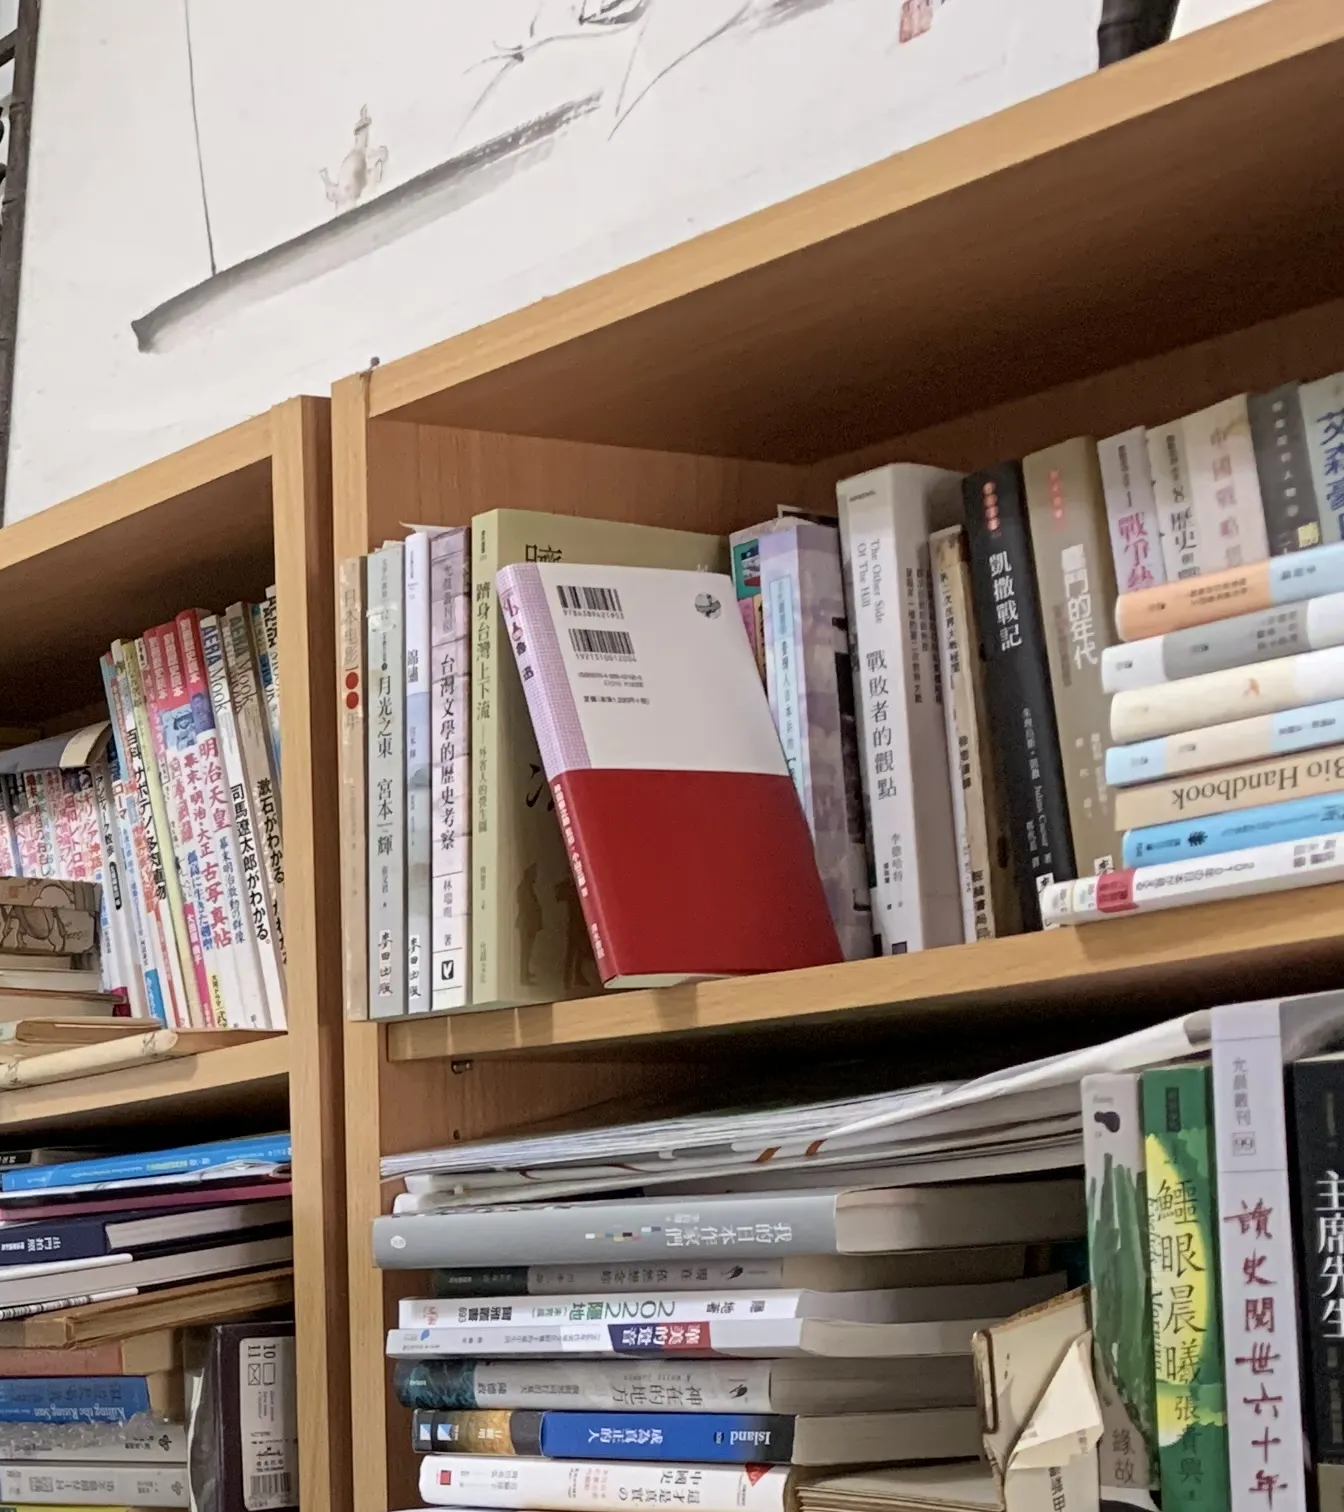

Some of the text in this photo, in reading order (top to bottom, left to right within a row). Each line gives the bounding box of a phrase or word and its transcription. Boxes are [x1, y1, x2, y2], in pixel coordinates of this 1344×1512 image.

[872, 563, 883, 595] Other
[987, 551, 1023, 652] 凱撒戰記
[377, 676, 393, 759] 月光之東
[439, 653, 457, 851] 台灣文學的歷史考察
[865, 650, 898, 799] 戰敗者的觀點
[197, 736, 231, 831] 明治天皇
[1171, 765, 1299, 811] Handbook
[201, 860, 234, 950] 古写真帖
[229, 783, 272, 945] 司馬遼太郎がわかる。
[664, 1221, 793, 1248] 我的日本作家們
[1154, 1178, 1206, 1385] 鱷眼晨曦
[611, 1384, 703, 1405] 神在的地方
[1223, 1199, 1288, 1512] 讀史閱世六十年
[50, 1403, 78, 1420] Rising
[94, 1403, 126, 1421] Killing
[587, 1427, 664, 1446] 成為真正的人
[729, 1430, 772, 1446] Island
